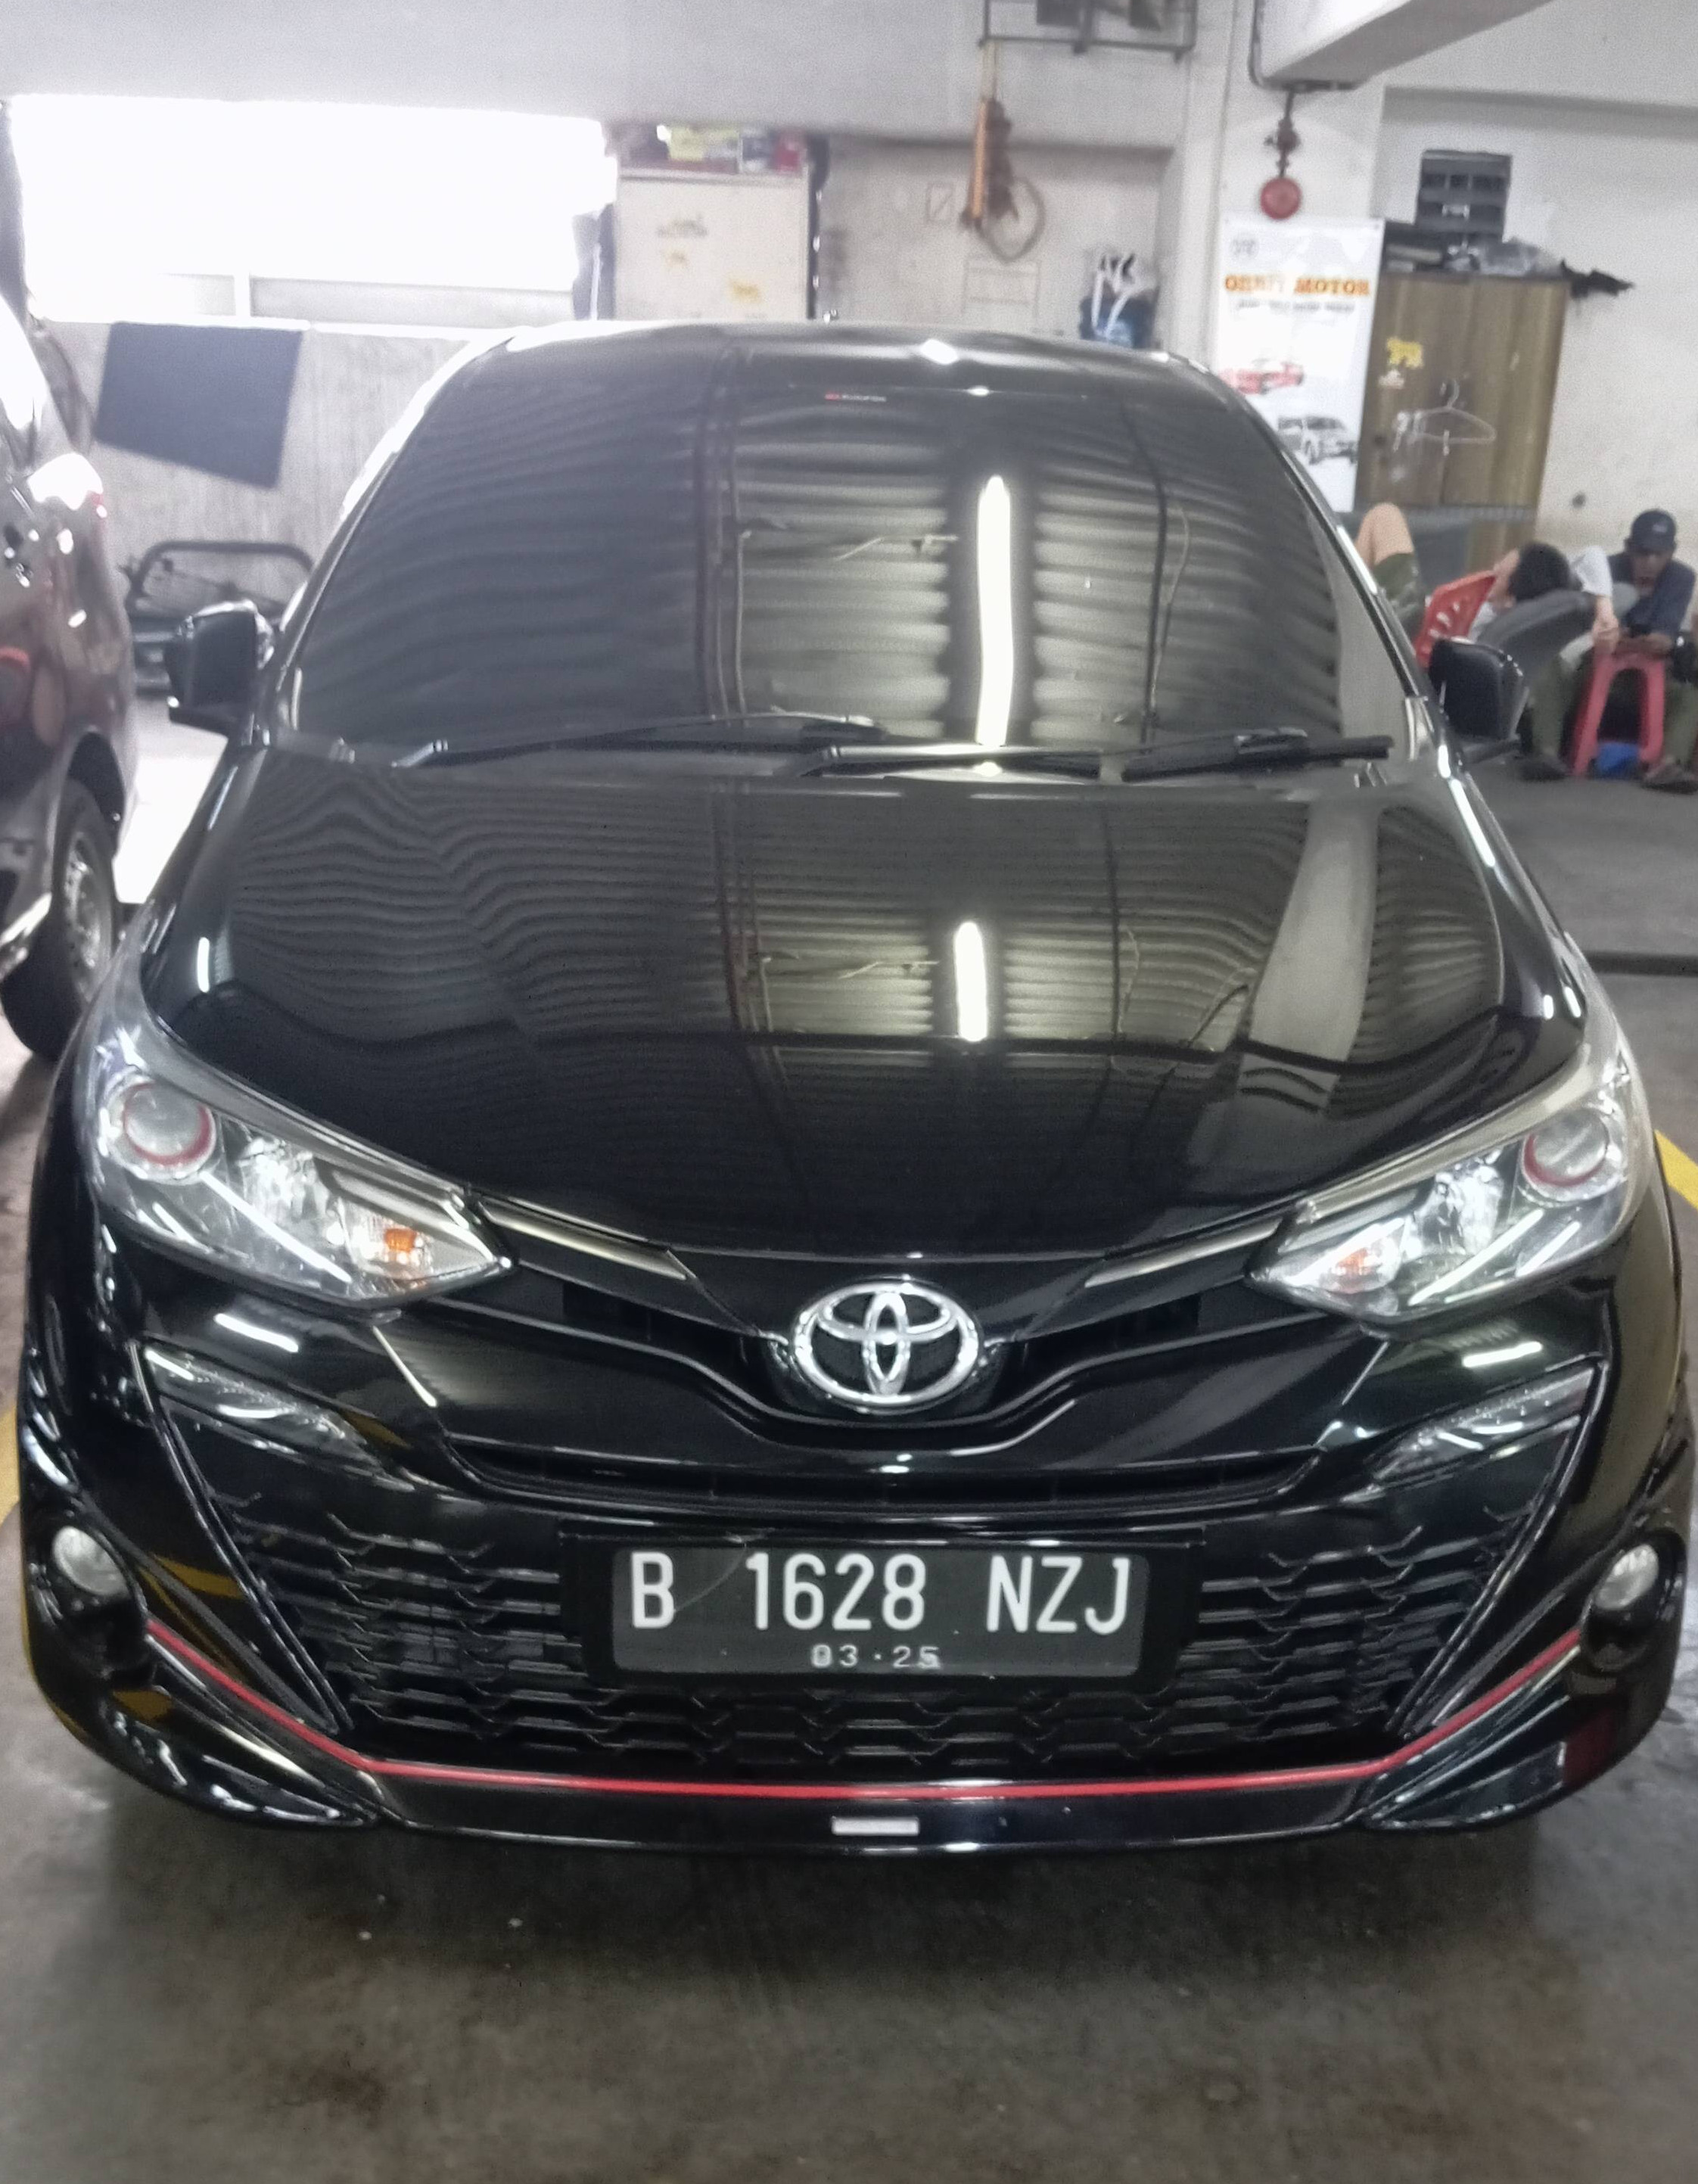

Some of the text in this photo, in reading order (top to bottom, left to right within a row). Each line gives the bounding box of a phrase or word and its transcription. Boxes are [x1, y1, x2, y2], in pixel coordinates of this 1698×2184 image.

[630, 1551, 1130, 1635] B 1628 NZJ
